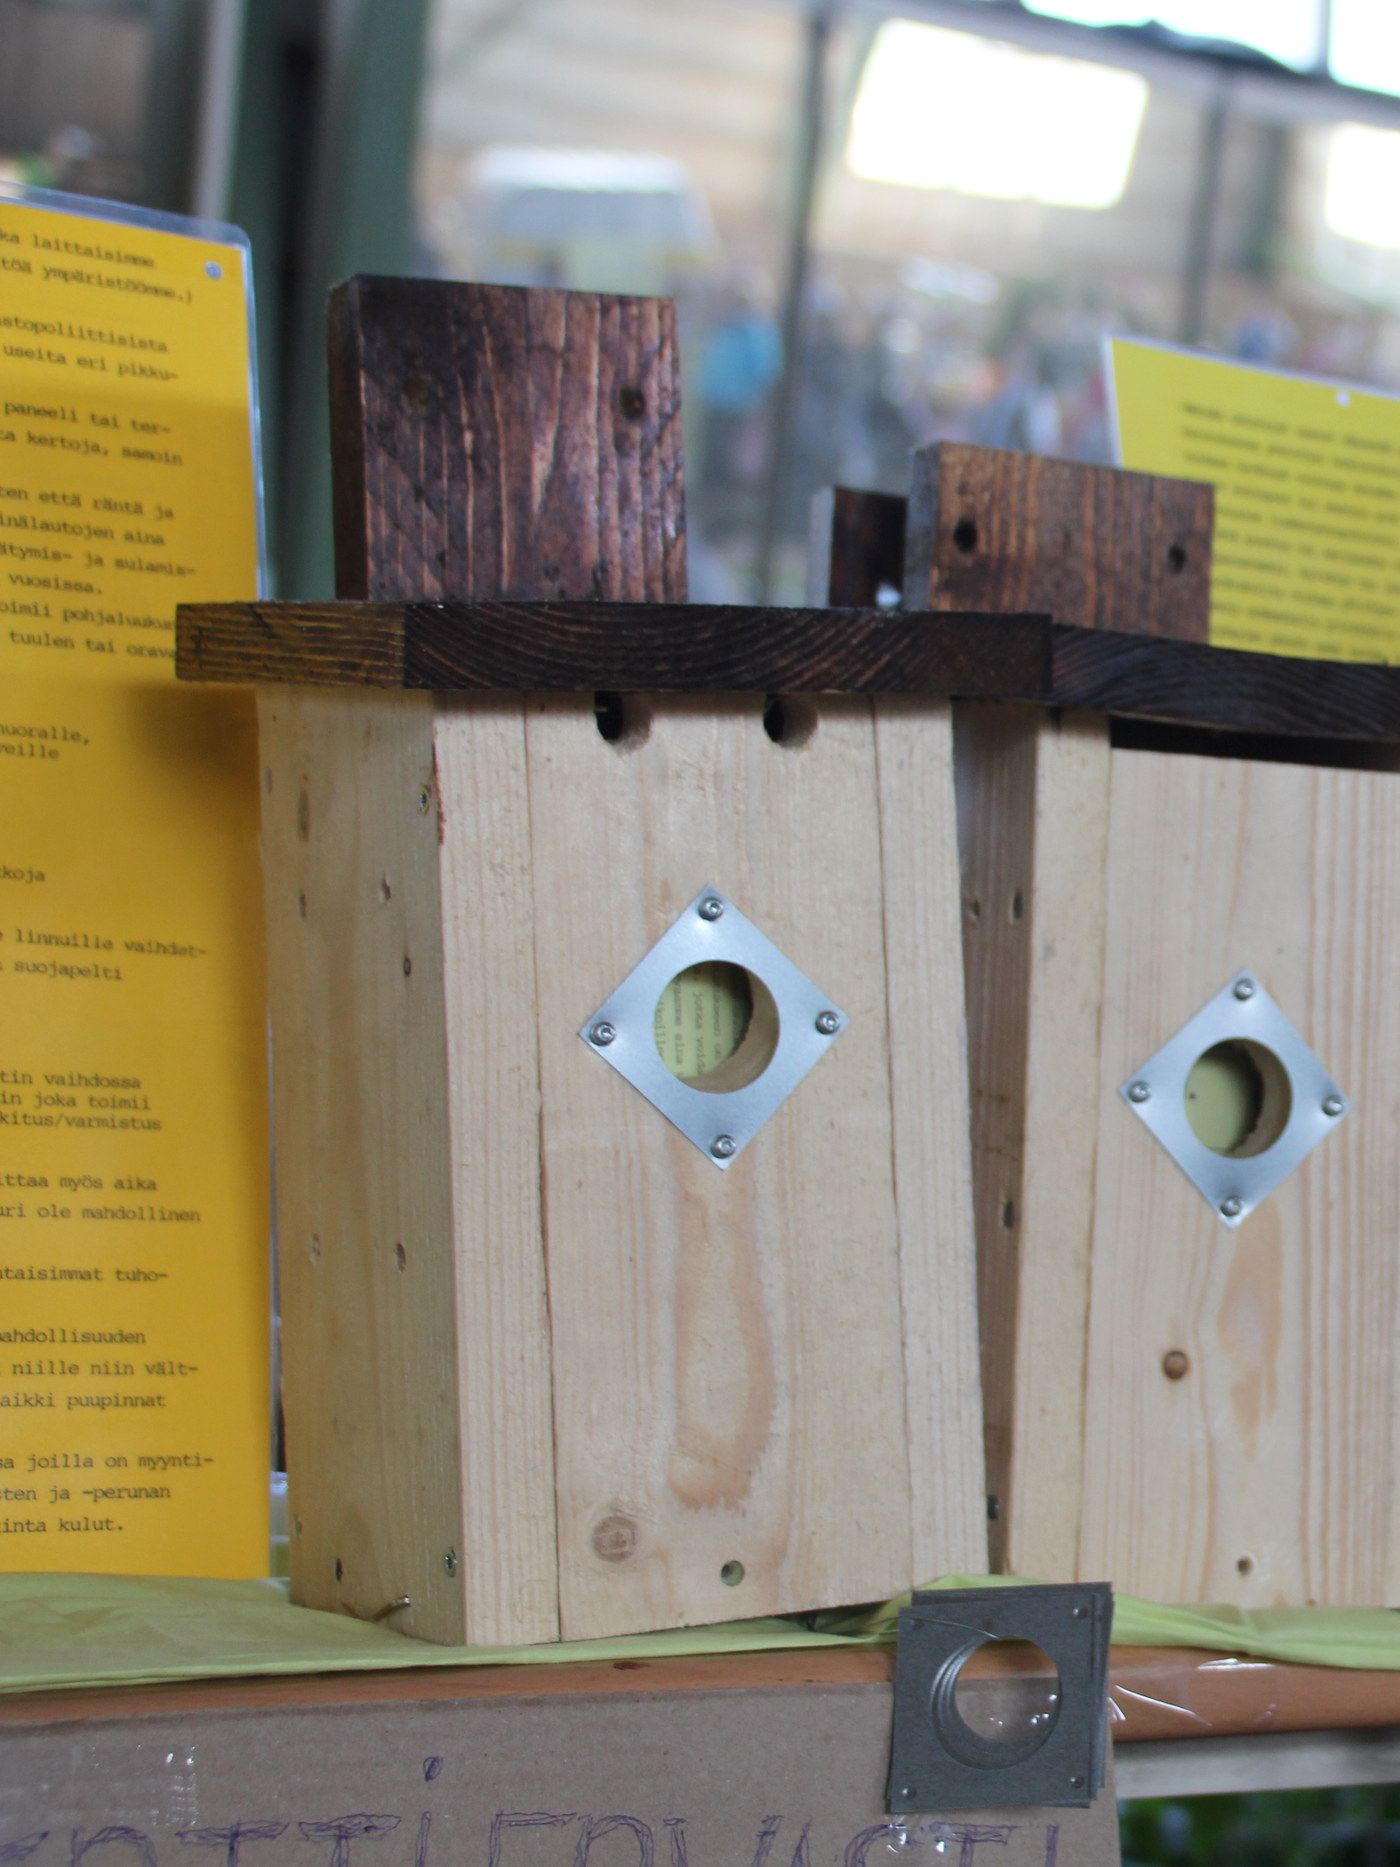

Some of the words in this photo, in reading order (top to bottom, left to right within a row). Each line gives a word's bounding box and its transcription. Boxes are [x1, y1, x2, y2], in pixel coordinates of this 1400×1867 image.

[77, 356, 108, 371] eri
[4, 401, 78, 423] paneeli
[90, 410, 119, 429] tai
[122, 445, 183, 466] samoin
[38, 489, 82, 508] että
[93, 498, 144, 515] räntä
[155, 503, 175, 522] ja
[124, 529, 165, 546] aina
[85, 553, 104, 569] ja
[9, 630, 75, 650] tuulen
[86, 637, 116, 654] tai
[15, 928, 114, 951] linnuille
[14, 960, 123, 981] suojapelti
[43, 1071, 142, 1090] vaihdossa
[34, 1091, 77, 1110] joka
[88, 1095, 152, 1111] toimii
[0, 1173, 49, 1188] ttaa
[59, 1175, 103, 1192] myös
[113, 1175, 158, 1192] aika
[37, 1203, 72, 1219] ole
[81, 1205, 201, 1223] mahdollinen
[0, 1266, 104, 1281] taisimmat
[115, 1267, 169, 1282] tuho-
[12, 1360, 80, 1376] niille
[90, 1360, 135, 1376] niin
[144, 1360, 199, 1376] vält-
[66, 1392, 168, 1411] puupinnat
[27, 1453, 94, 1472] joilla
[105, 1456, 128, 1468] on
[138, 1452, 214, 1471] myynti-
[48, 1485, 71, 1504] ja
[82, 1486, 171, 1503] -perunan
[58, 1516, 124, 1533] kulut.
